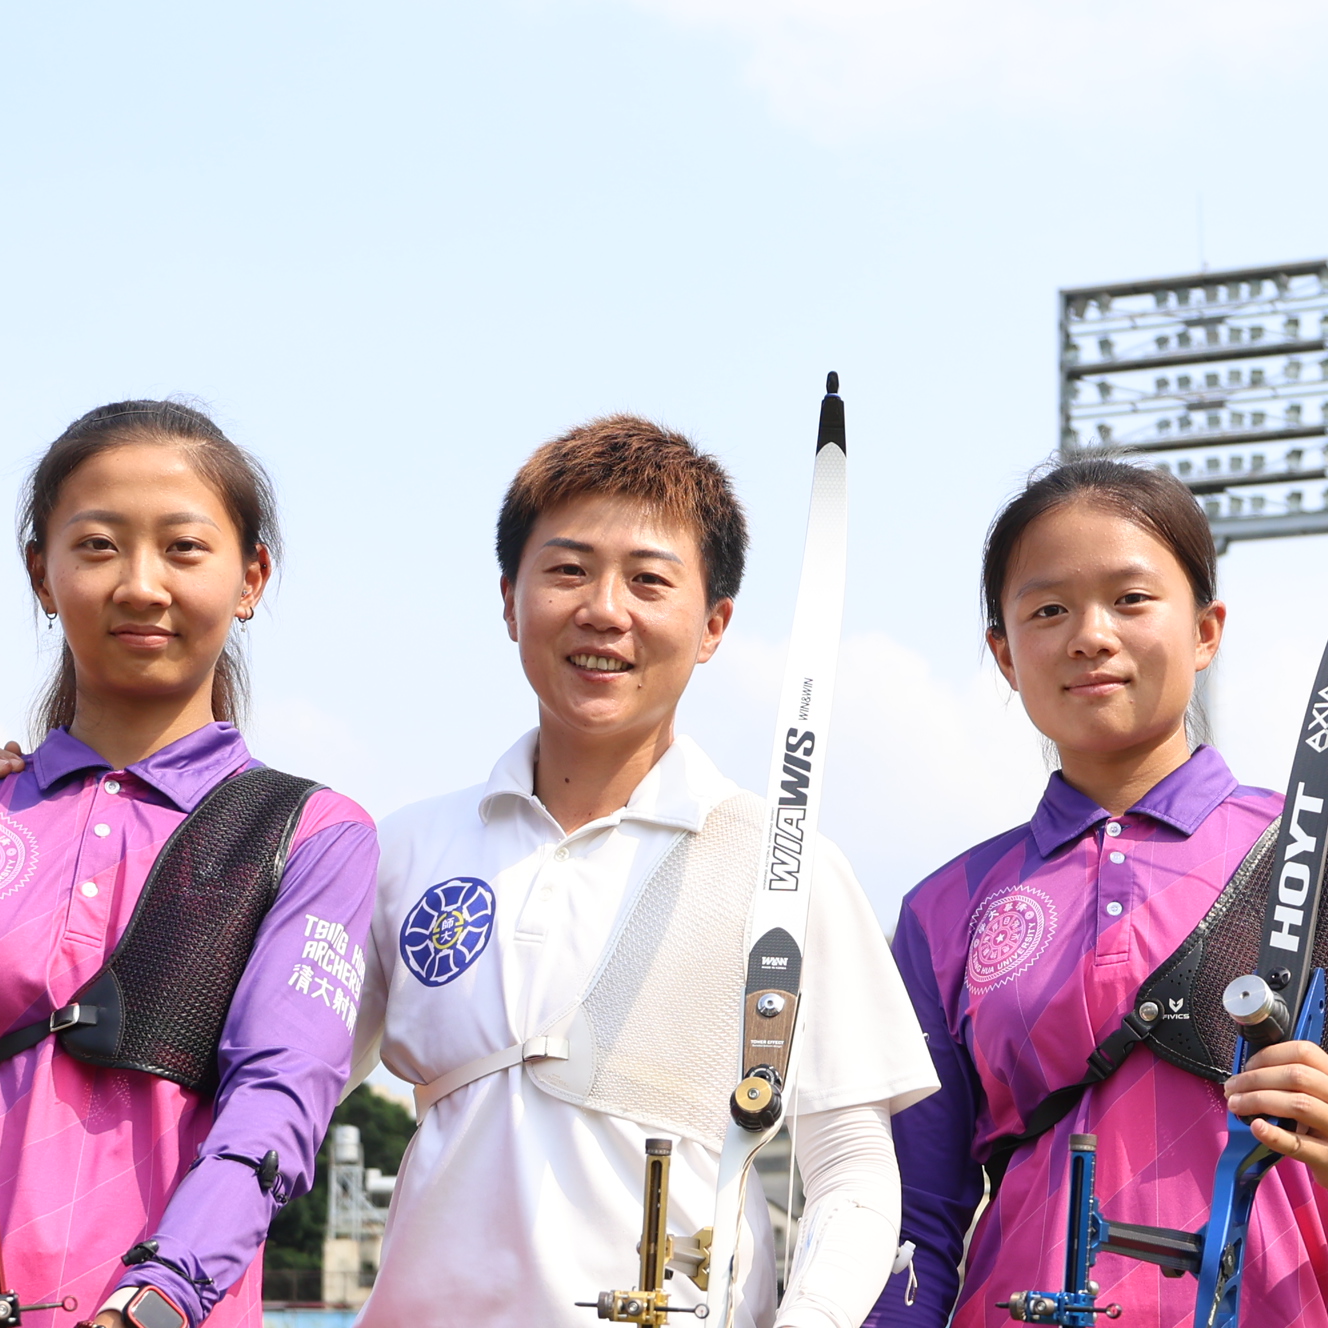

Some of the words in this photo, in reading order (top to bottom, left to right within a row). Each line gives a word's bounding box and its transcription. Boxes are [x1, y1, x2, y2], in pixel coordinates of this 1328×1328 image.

[798, 677, 813, 721] WIN&WIN
[768, 727, 815, 891] WIAWIS
[1269, 781, 1324, 952] HOYT
[304, 913, 349, 956] TSING
[440, 916, 455, 943] 師大
[997, 922, 1036, 969] UNIVERSITY
[301, 940, 362, 1002] ARCHERY
[761, 956, 789, 966] W&W
